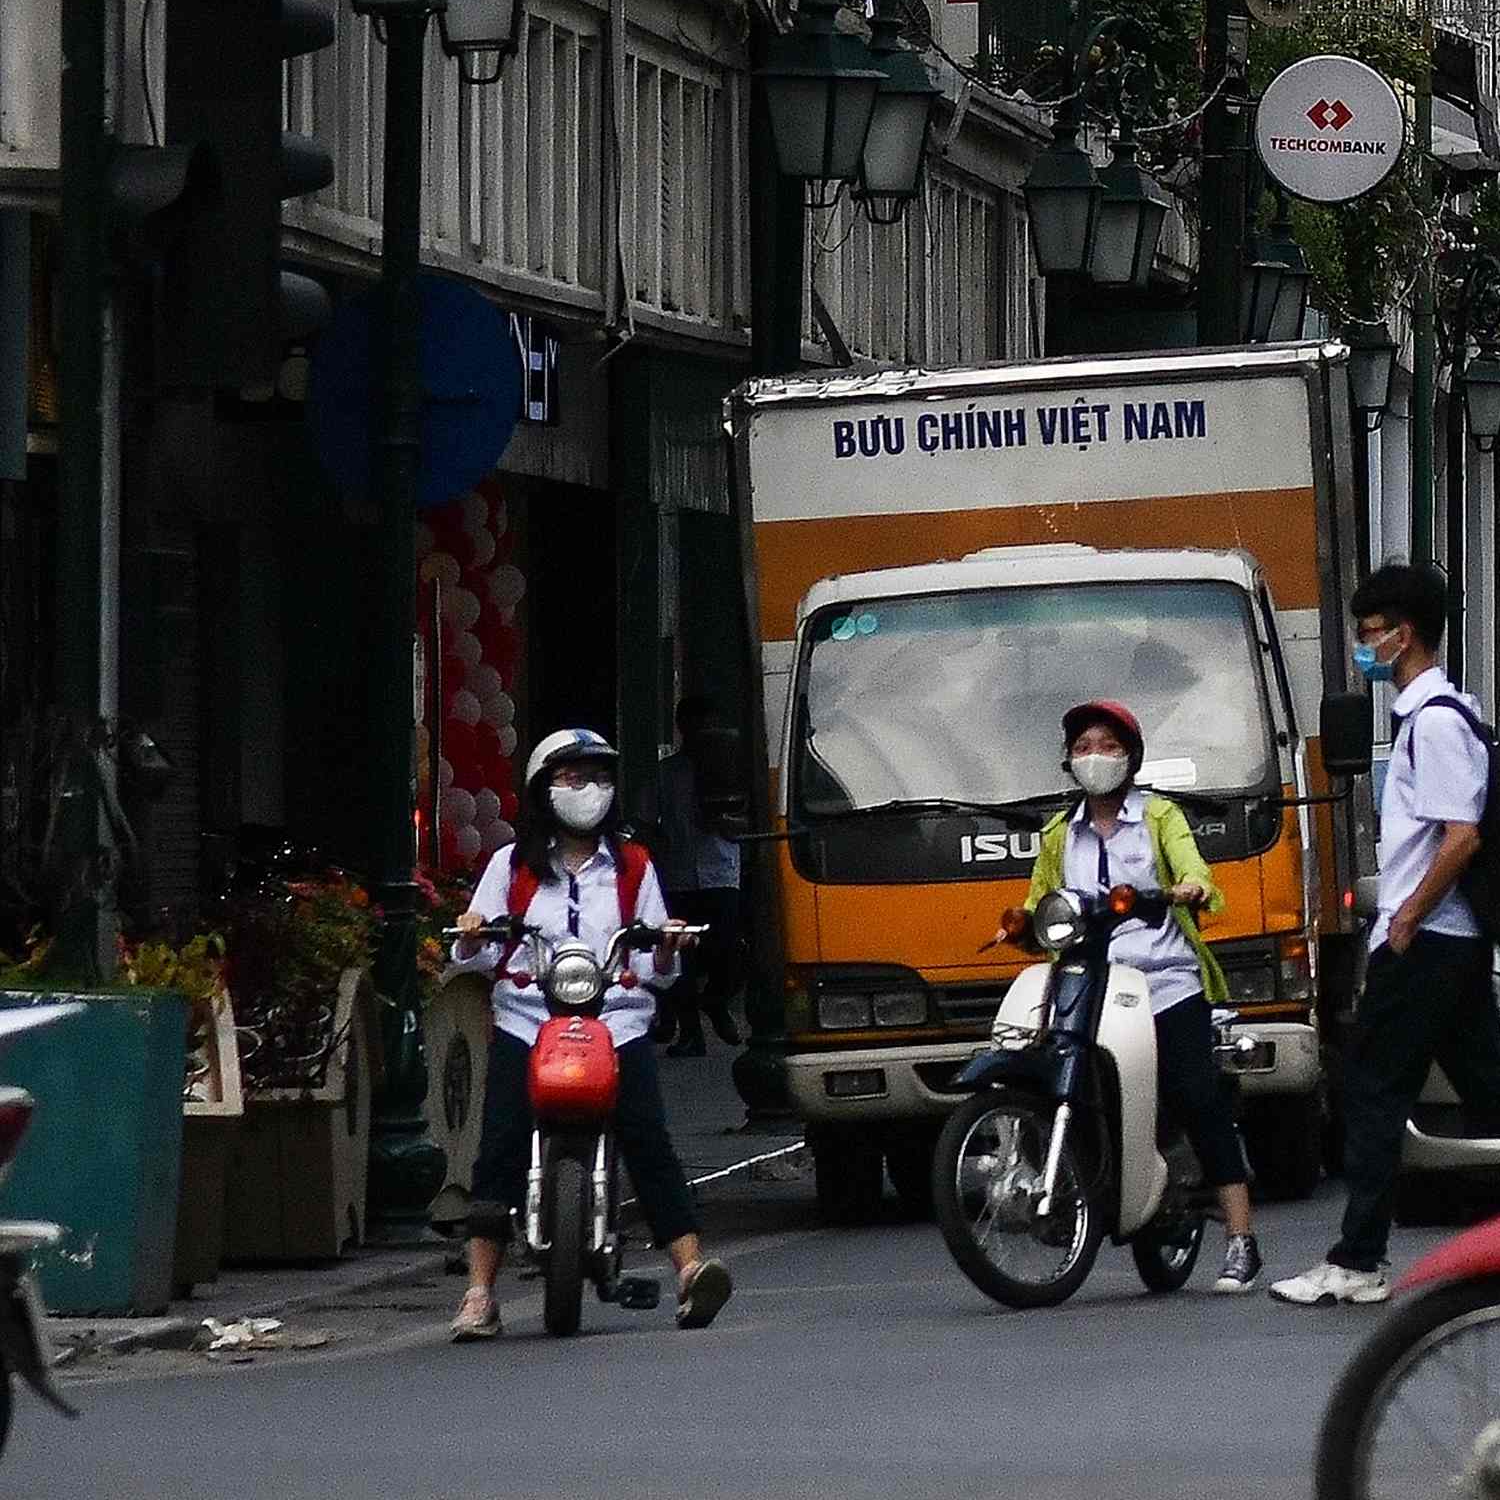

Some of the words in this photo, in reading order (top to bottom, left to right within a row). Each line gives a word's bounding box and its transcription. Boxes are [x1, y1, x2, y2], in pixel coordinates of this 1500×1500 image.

[1269, 136, 1387, 157] TECHCOMBANK
[833, 414, 905, 458] BƯU
[916, 403, 1026, 456] CHÍNH
[1036, 397, 1111, 451] VIỆT
[1123, 400, 1207, 442] NAM
[960, 831, 1041, 864] ISU
